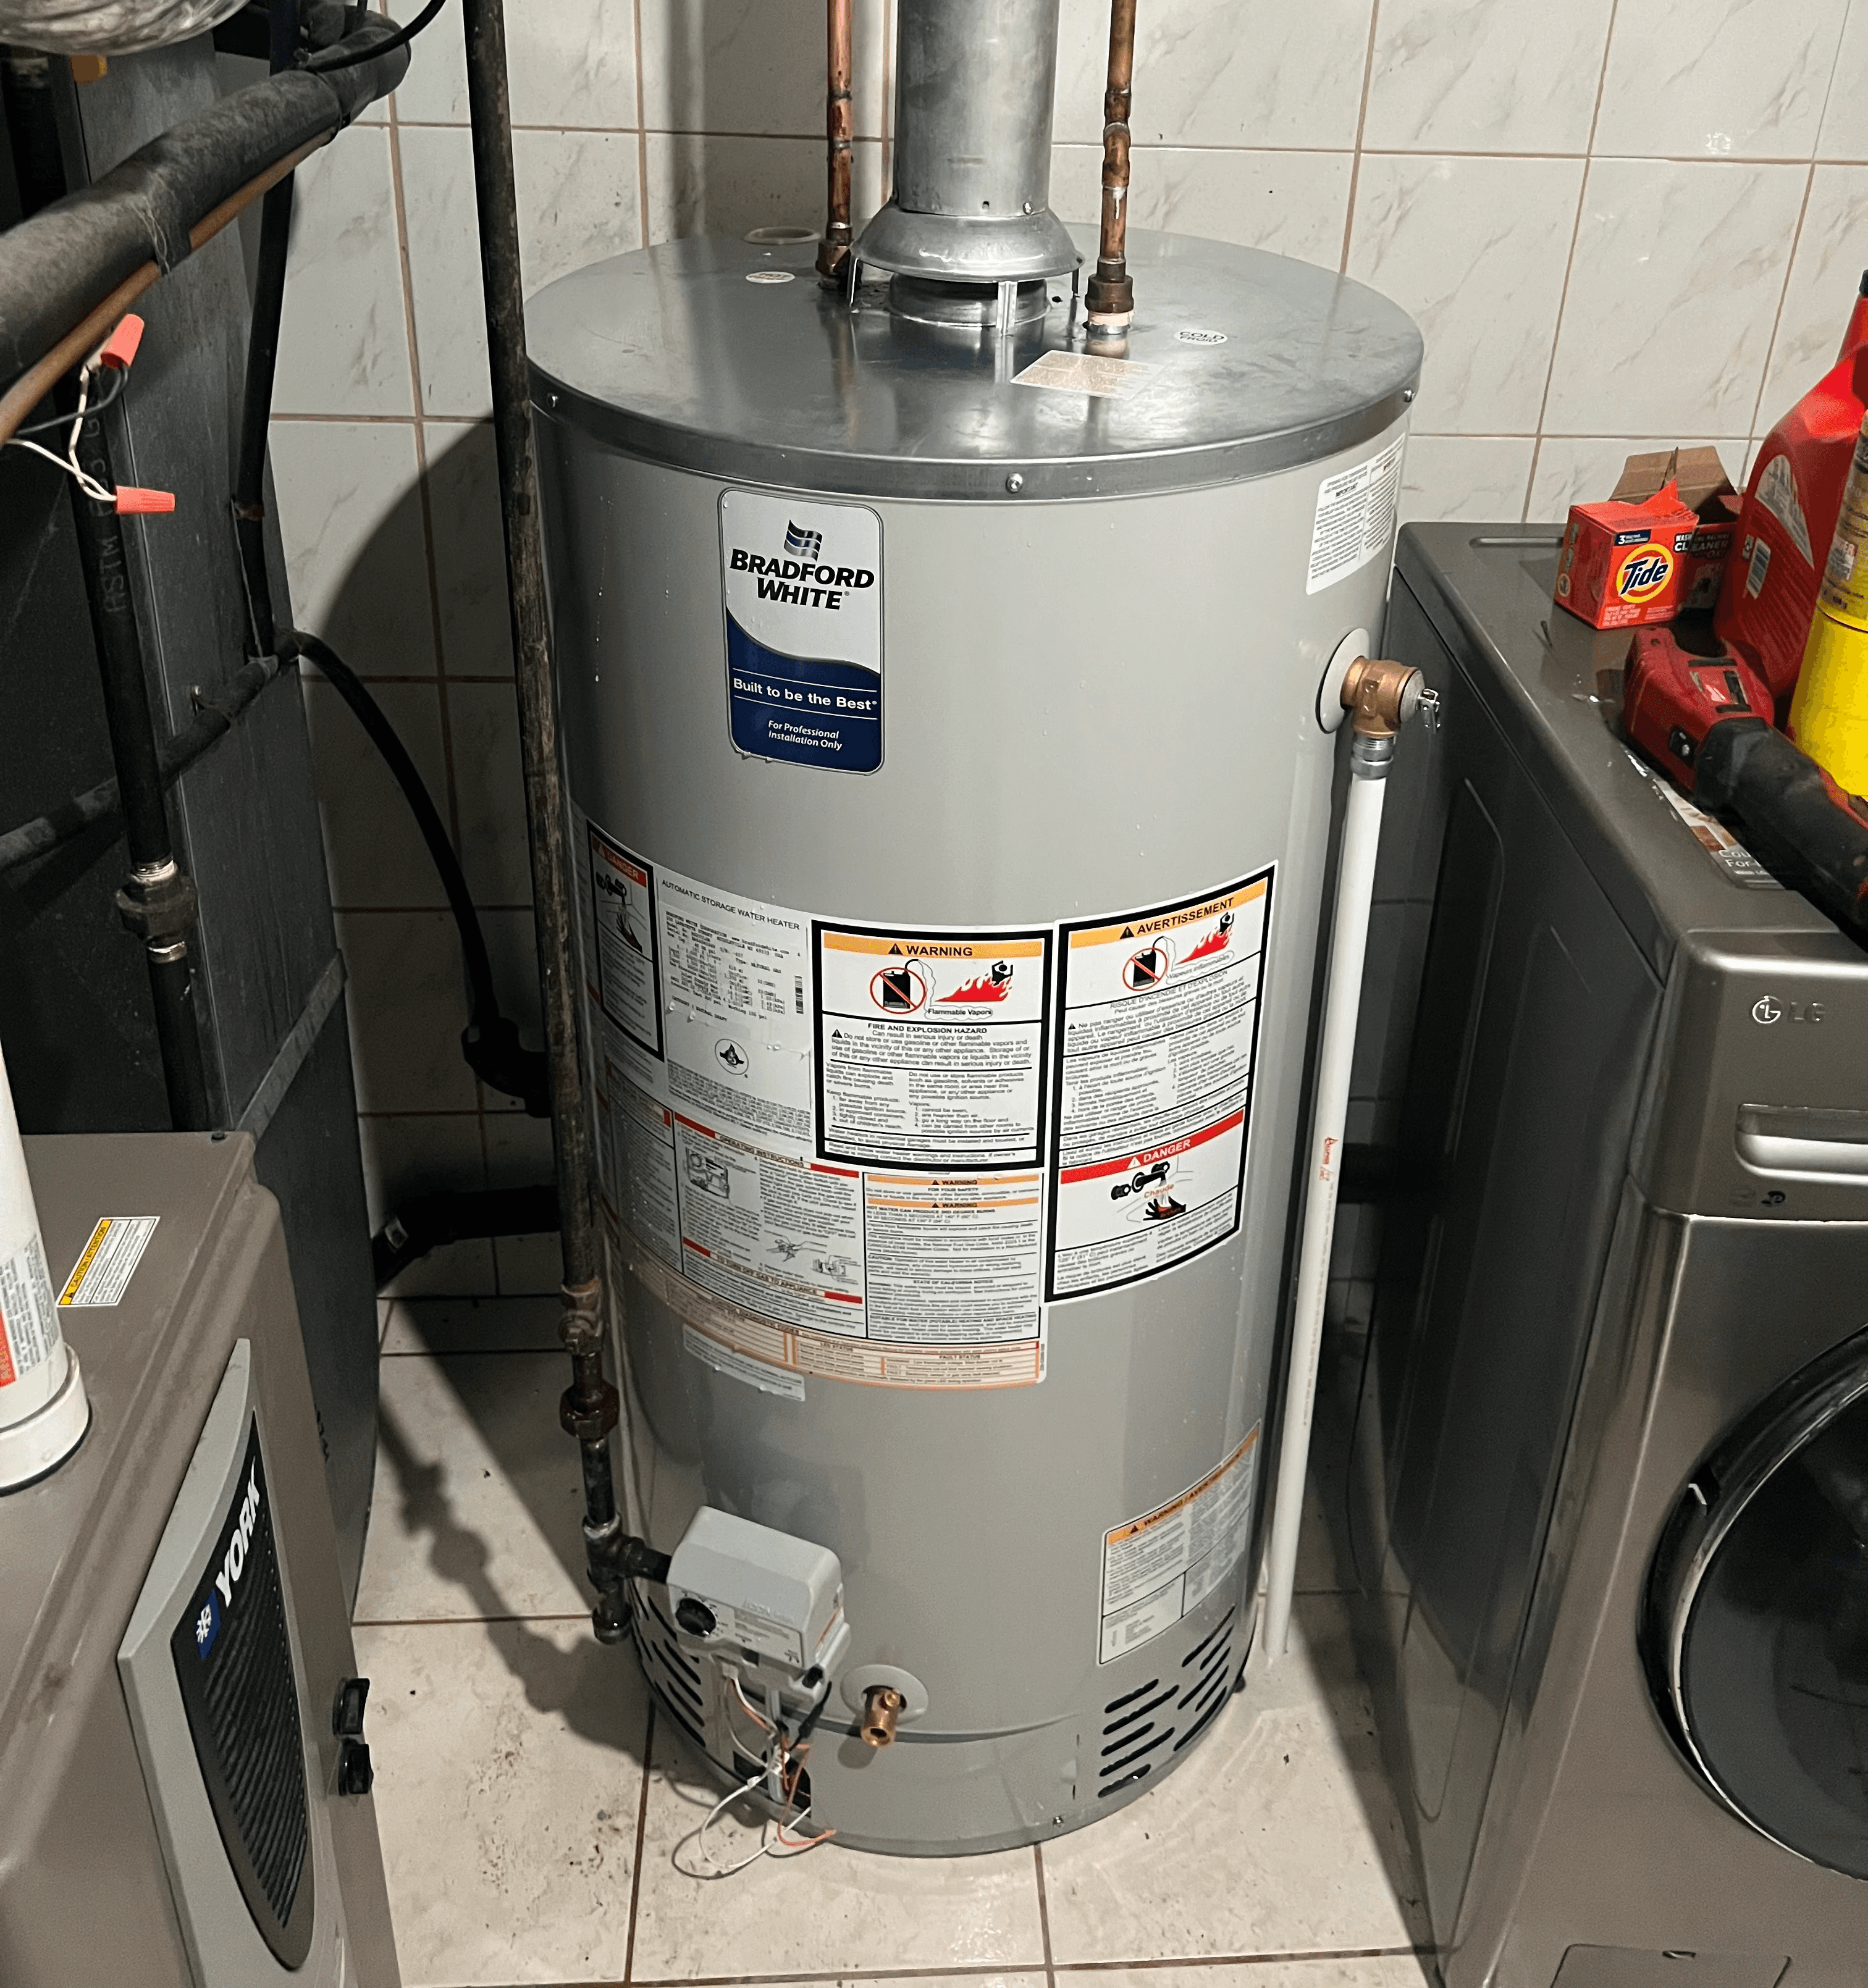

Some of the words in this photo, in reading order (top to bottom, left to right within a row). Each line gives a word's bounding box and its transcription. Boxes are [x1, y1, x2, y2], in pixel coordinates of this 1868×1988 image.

[1618, 535, 1626, 545] 3
[729, 548, 875, 589] BRADFORD
[1620, 556, 1669, 596] Tide
[757, 577, 843, 611] WHITE
[733, 677, 763, 695] Built
[766, 684, 780, 698] to
[785, 688, 803, 703] be
[807, 692, 831, 707] the
[768, 719, 783, 731] For
[784, 723, 839, 739] Professional
[768, 730, 818, 747] Installation
[820, 739, 843, 752] Only
[1719, 849, 1752, 858] Cou
[662, 879, 700, 901] AUTOMATIC
[701, 895, 736, 914] STORAGE
[737, 908, 765, 923] WATER
[767, 916, 801, 930] HEATER
[1137, 897, 1235, 935] AVERTISSEMENT
[906, 944, 974, 957] WARNING
[928, 1007, 966, 1016] Flammable
[967, 1008, 992, 1017] Vapors
[1787, 1002, 1827, 1024] LG
[1143, 1138, 1191, 1163] DANGER
[216, 1454, 260, 1608] YORK
